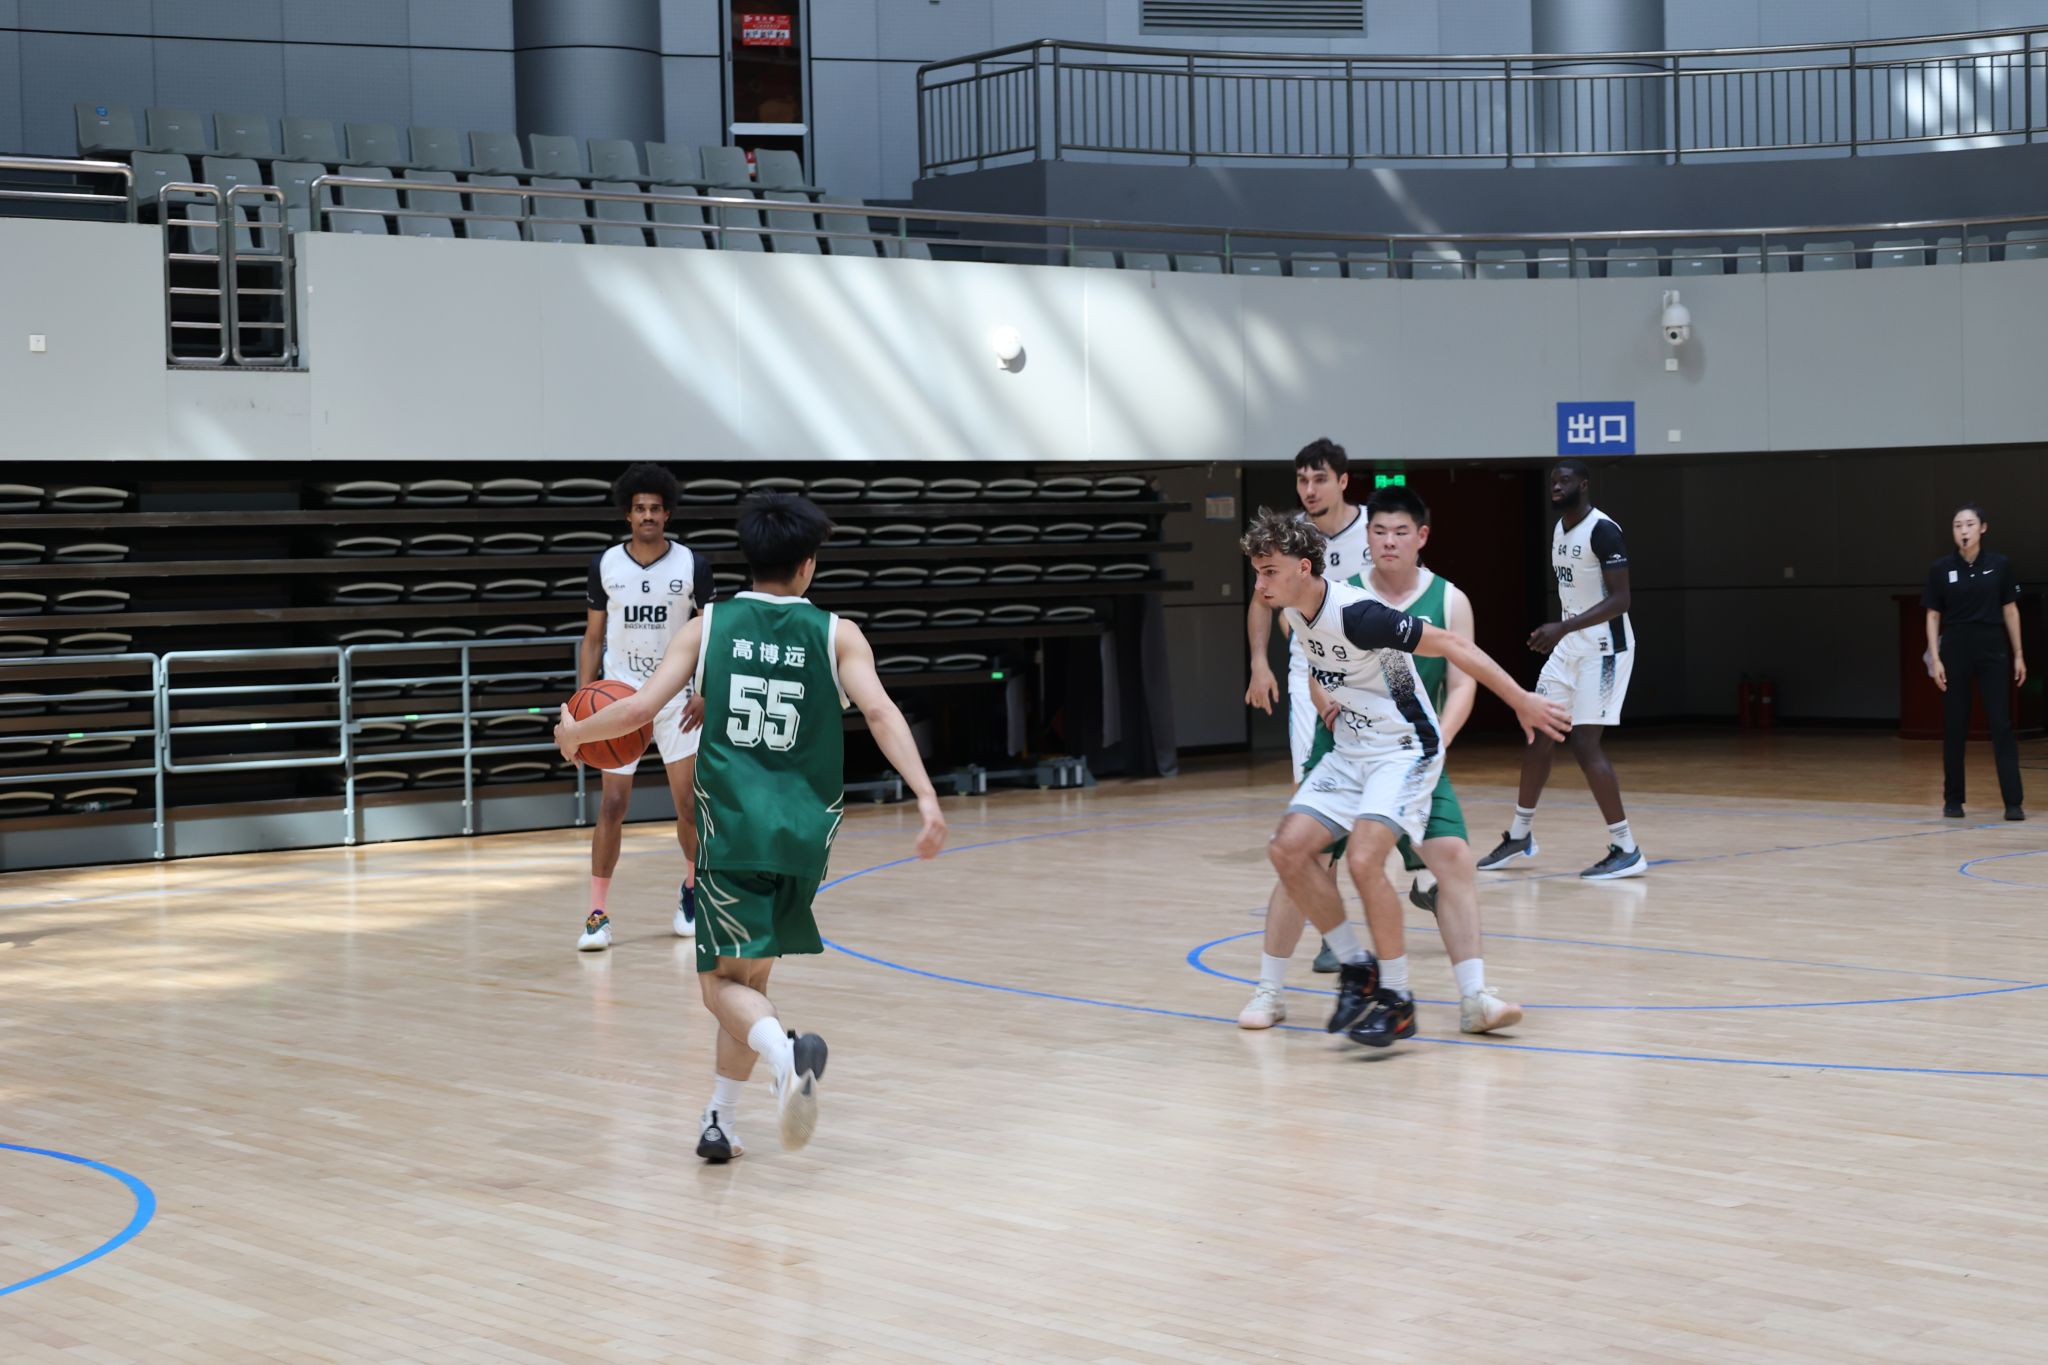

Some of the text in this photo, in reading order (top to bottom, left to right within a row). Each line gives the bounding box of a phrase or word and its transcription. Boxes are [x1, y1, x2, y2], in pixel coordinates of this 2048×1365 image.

[1567, 413, 1627, 443] 出口
[1330, 552, 1340, 566] 8
[641, 581, 650, 593] 6
[624, 605, 667, 623] URB
[732, 639, 806, 668] 高博远
[1308, 640, 1325, 657] 33
[726, 673, 805, 752] 55
